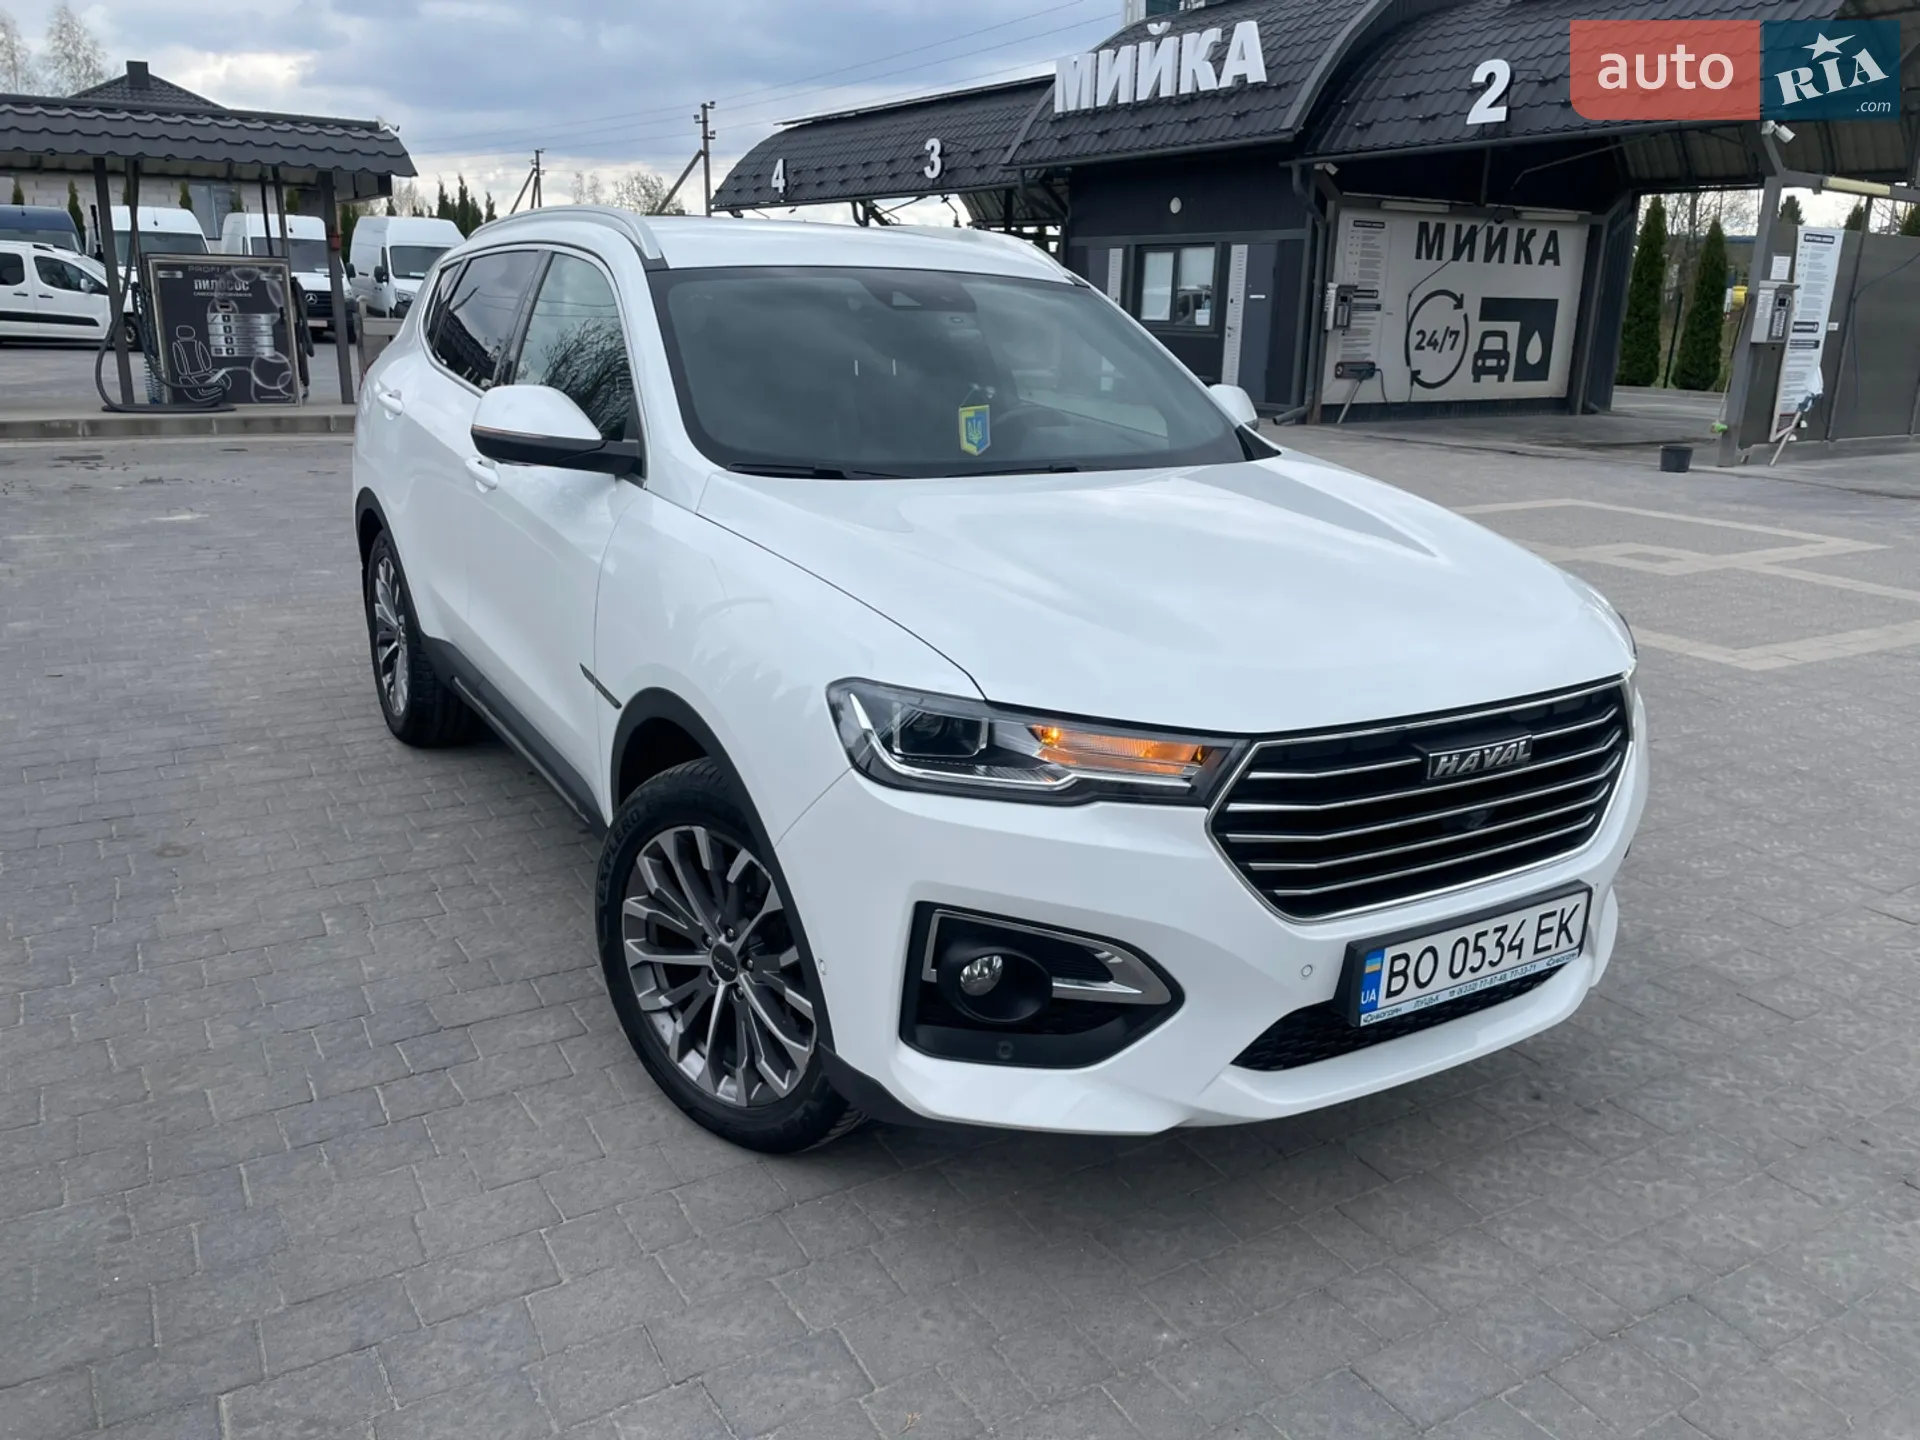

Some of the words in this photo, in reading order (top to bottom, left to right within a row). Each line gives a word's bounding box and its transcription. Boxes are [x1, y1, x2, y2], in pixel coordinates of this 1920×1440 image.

[1054, 20, 1267, 114] МИЙКА
[1466, 59, 1511, 125] 2
[771, 158, 786, 193] 4
[924, 138, 942, 179] 3
[1415, 218, 1561, 266] МИЙКА
[1414, 326, 1460, 356] 24/7
[1433, 740, 1531, 777] HAVAL
[1385, 945, 1439, 1000] BO
[1449, 918, 1526, 980] 0534
[1533, 902, 1581, 957] EK
[1361, 991, 1376, 1005] UA
